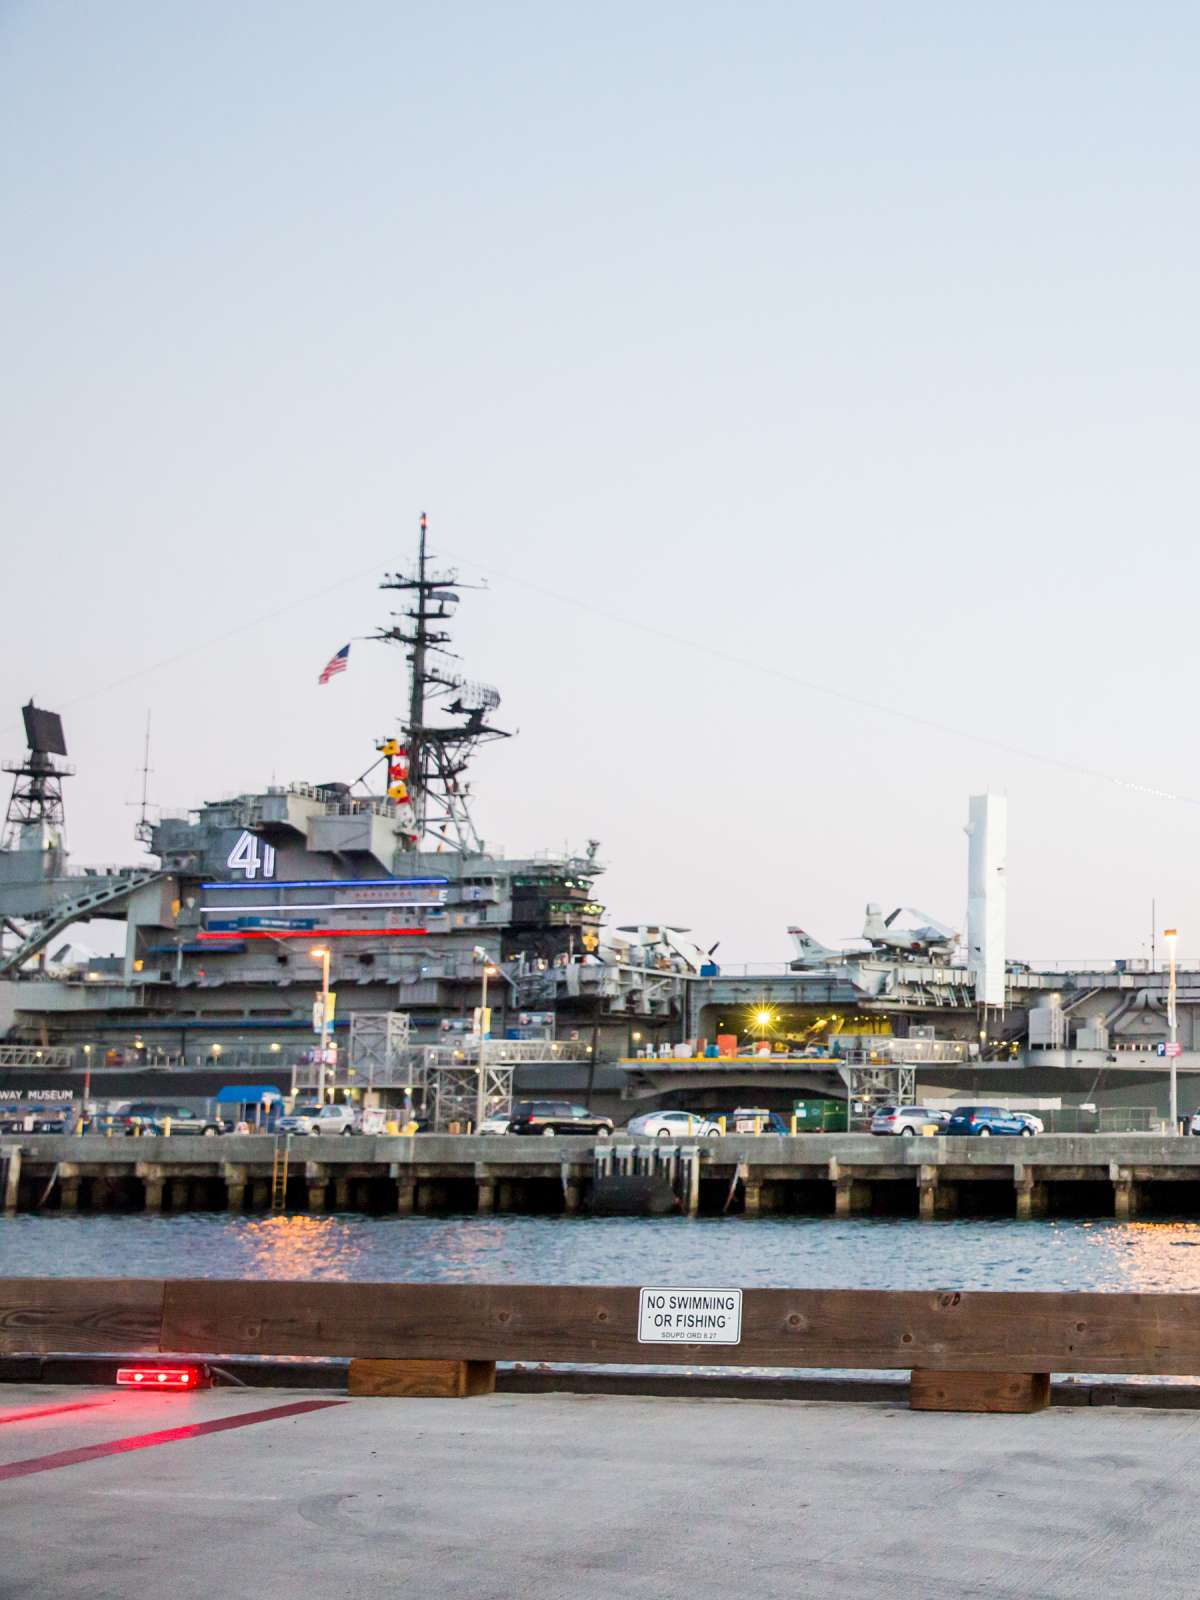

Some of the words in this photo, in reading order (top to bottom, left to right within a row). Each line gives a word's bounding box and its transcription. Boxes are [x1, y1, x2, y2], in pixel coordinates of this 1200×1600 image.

[227, 830, 275, 878] 41
[1157, 1044, 1165, 1055] P
[0, 1090, 22, 1100] WAY
[28, 1090, 73, 1100] MUSEUM
[647, 1296, 665, 1309] NO
[669, 1296, 735, 1310] SWIMMING
[654, 1314, 672, 1327] OR
[676, 1314, 726, 1328] FISHING
